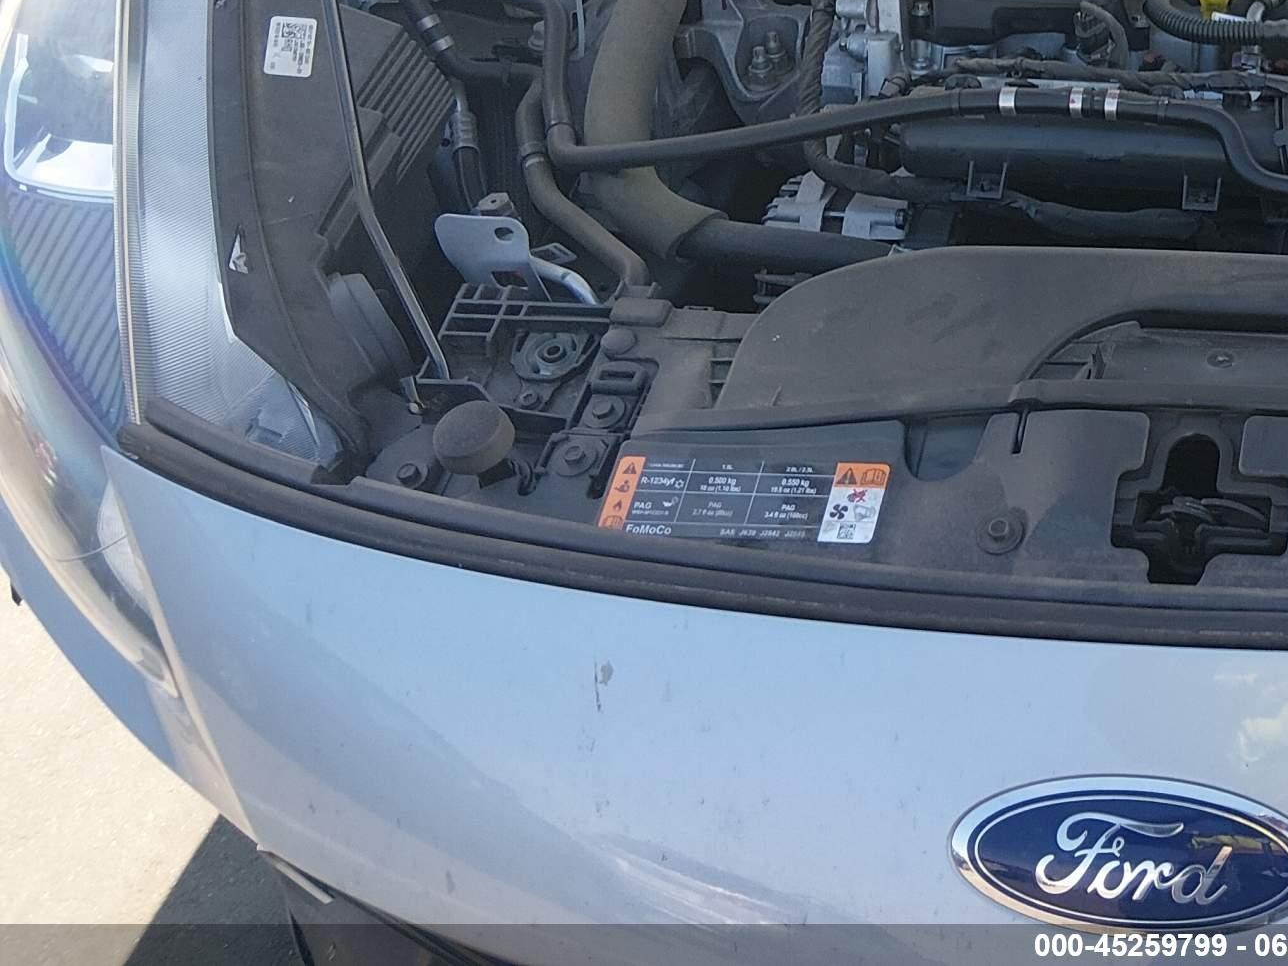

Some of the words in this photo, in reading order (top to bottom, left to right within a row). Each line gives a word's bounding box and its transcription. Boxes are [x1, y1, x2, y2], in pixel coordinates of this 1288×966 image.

[640, 476, 676, 487] R-1234yf
[708, 476, 727, 484] 0.500
[727, 477, 737, 486] kg
[781, 478, 800, 486] 0.550
[800, 479, 810, 487] kg
[633, 501, 653, 510] PAG
[625, 523, 672, 536] FoMoCo
[1035, 811, 1233, 906] Ford
